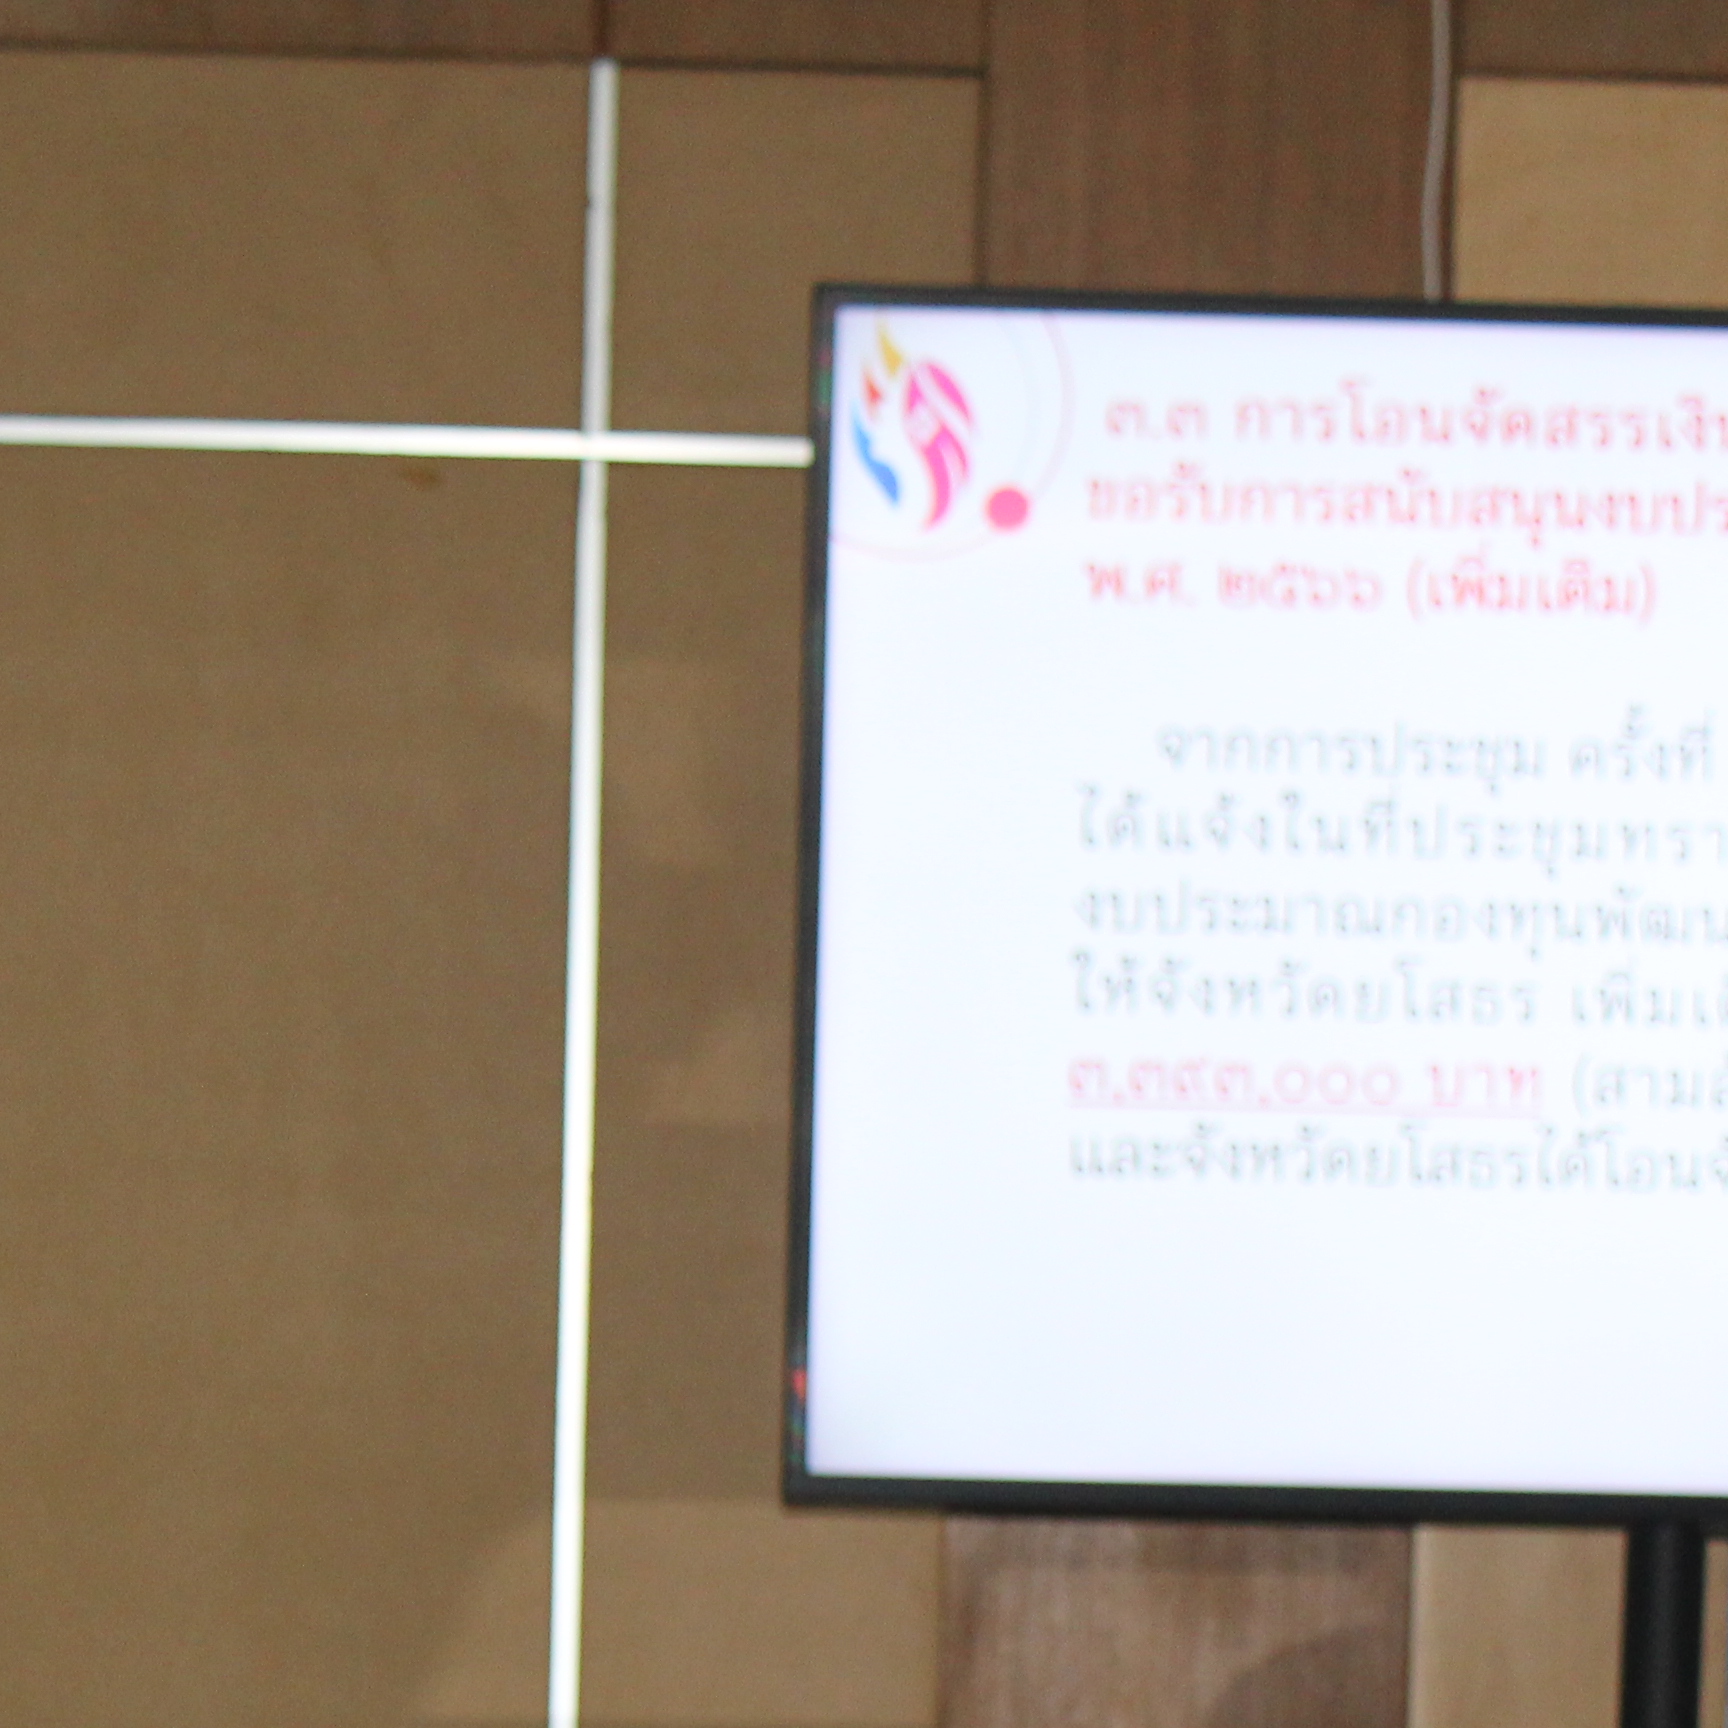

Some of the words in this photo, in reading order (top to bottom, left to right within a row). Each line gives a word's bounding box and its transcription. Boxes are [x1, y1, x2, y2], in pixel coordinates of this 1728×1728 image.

[1086, 558, 1192, 603] พ.ศ.
[1218, 561, 1384, 611] ๒๕๖๖
[1405, 545, 1657, 621] (เพิ่มเติม)
[1155, 720, 1547, 795] จากการประชุม
[1570, 704, 1716, 781] ครั้งที่
[1069, 946, 1540, 1027] ให้จังหวัดยโสธร
[1428, 1060, 1542, 1110] บาท
